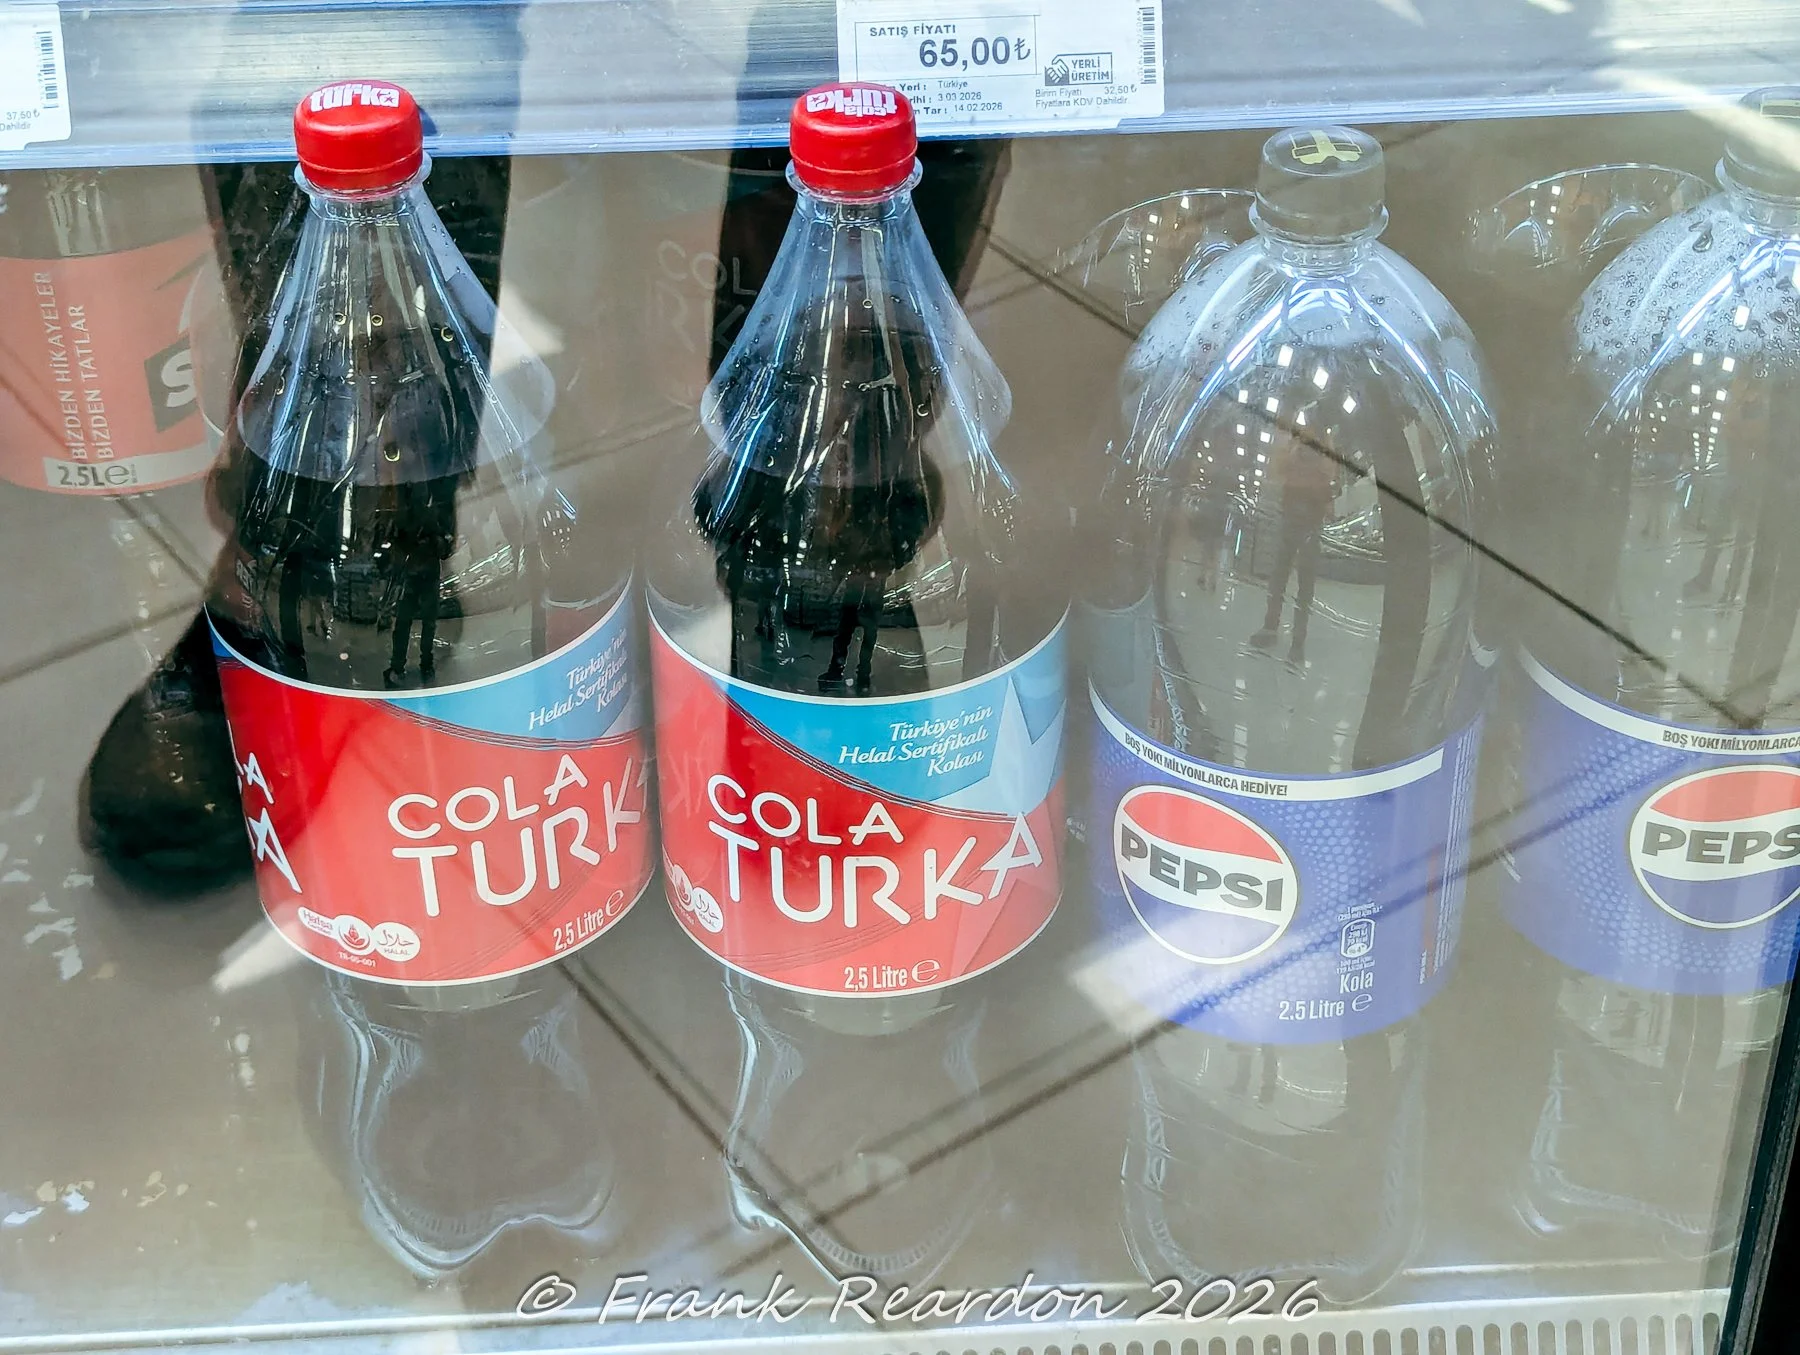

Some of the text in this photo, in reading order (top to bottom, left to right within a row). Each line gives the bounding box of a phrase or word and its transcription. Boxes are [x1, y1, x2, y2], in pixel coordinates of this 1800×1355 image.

[870, 23, 956, 38] SATIŞ FİYATI
[1071, 56, 1100, 69] YERLİ
[1071, 70, 1110, 81] ÜRETİM
[937, 80, 968, 91] Türkiye
[1035, 89, 1057, 98] Birim
[1035, 99, 1071, 109] Fiyatlara
[1073, 97, 1094, 106] KDV
[925, 106, 941, 115] Tar
[657, 239, 758, 295] COL
[33, 272, 88, 461] BİZDEN HİKAYELER
[68, 304, 115, 460] BİZDEN TATLAR
[529, 693, 576, 731] Helal
[890, 706, 993, 742] Türkiye'nin
[839, 724, 989, 764] Helal Sertifikalı
[1662, 729, 1688, 748] BOŞ
[927, 750, 984, 777] Kolası
[1125, 732, 1141, 755] BOŞ
[1164, 758, 1238, 790] MİLYONLARCA
[1240, 780, 1288, 796] HEDİYE!
[388, 753, 589, 840] COLA
[707, 774, 904, 848] COLA
[1642, 821, 1800, 864] PEPS
[708, 811, 1043, 929] TURKA
[1121, 823, 1284, 912] PEPSI
[553, 921, 575, 951] 2,5
[576, 908, 604, 939] Litre
[844, 966, 868, 992] 2,5
[872, 965, 908, 989] Litre
[1339, 969, 1374, 994] Kola
[1279, 1000, 1306, 1020] 2.5
[1309, 1000, 1345, 1019] Litre
